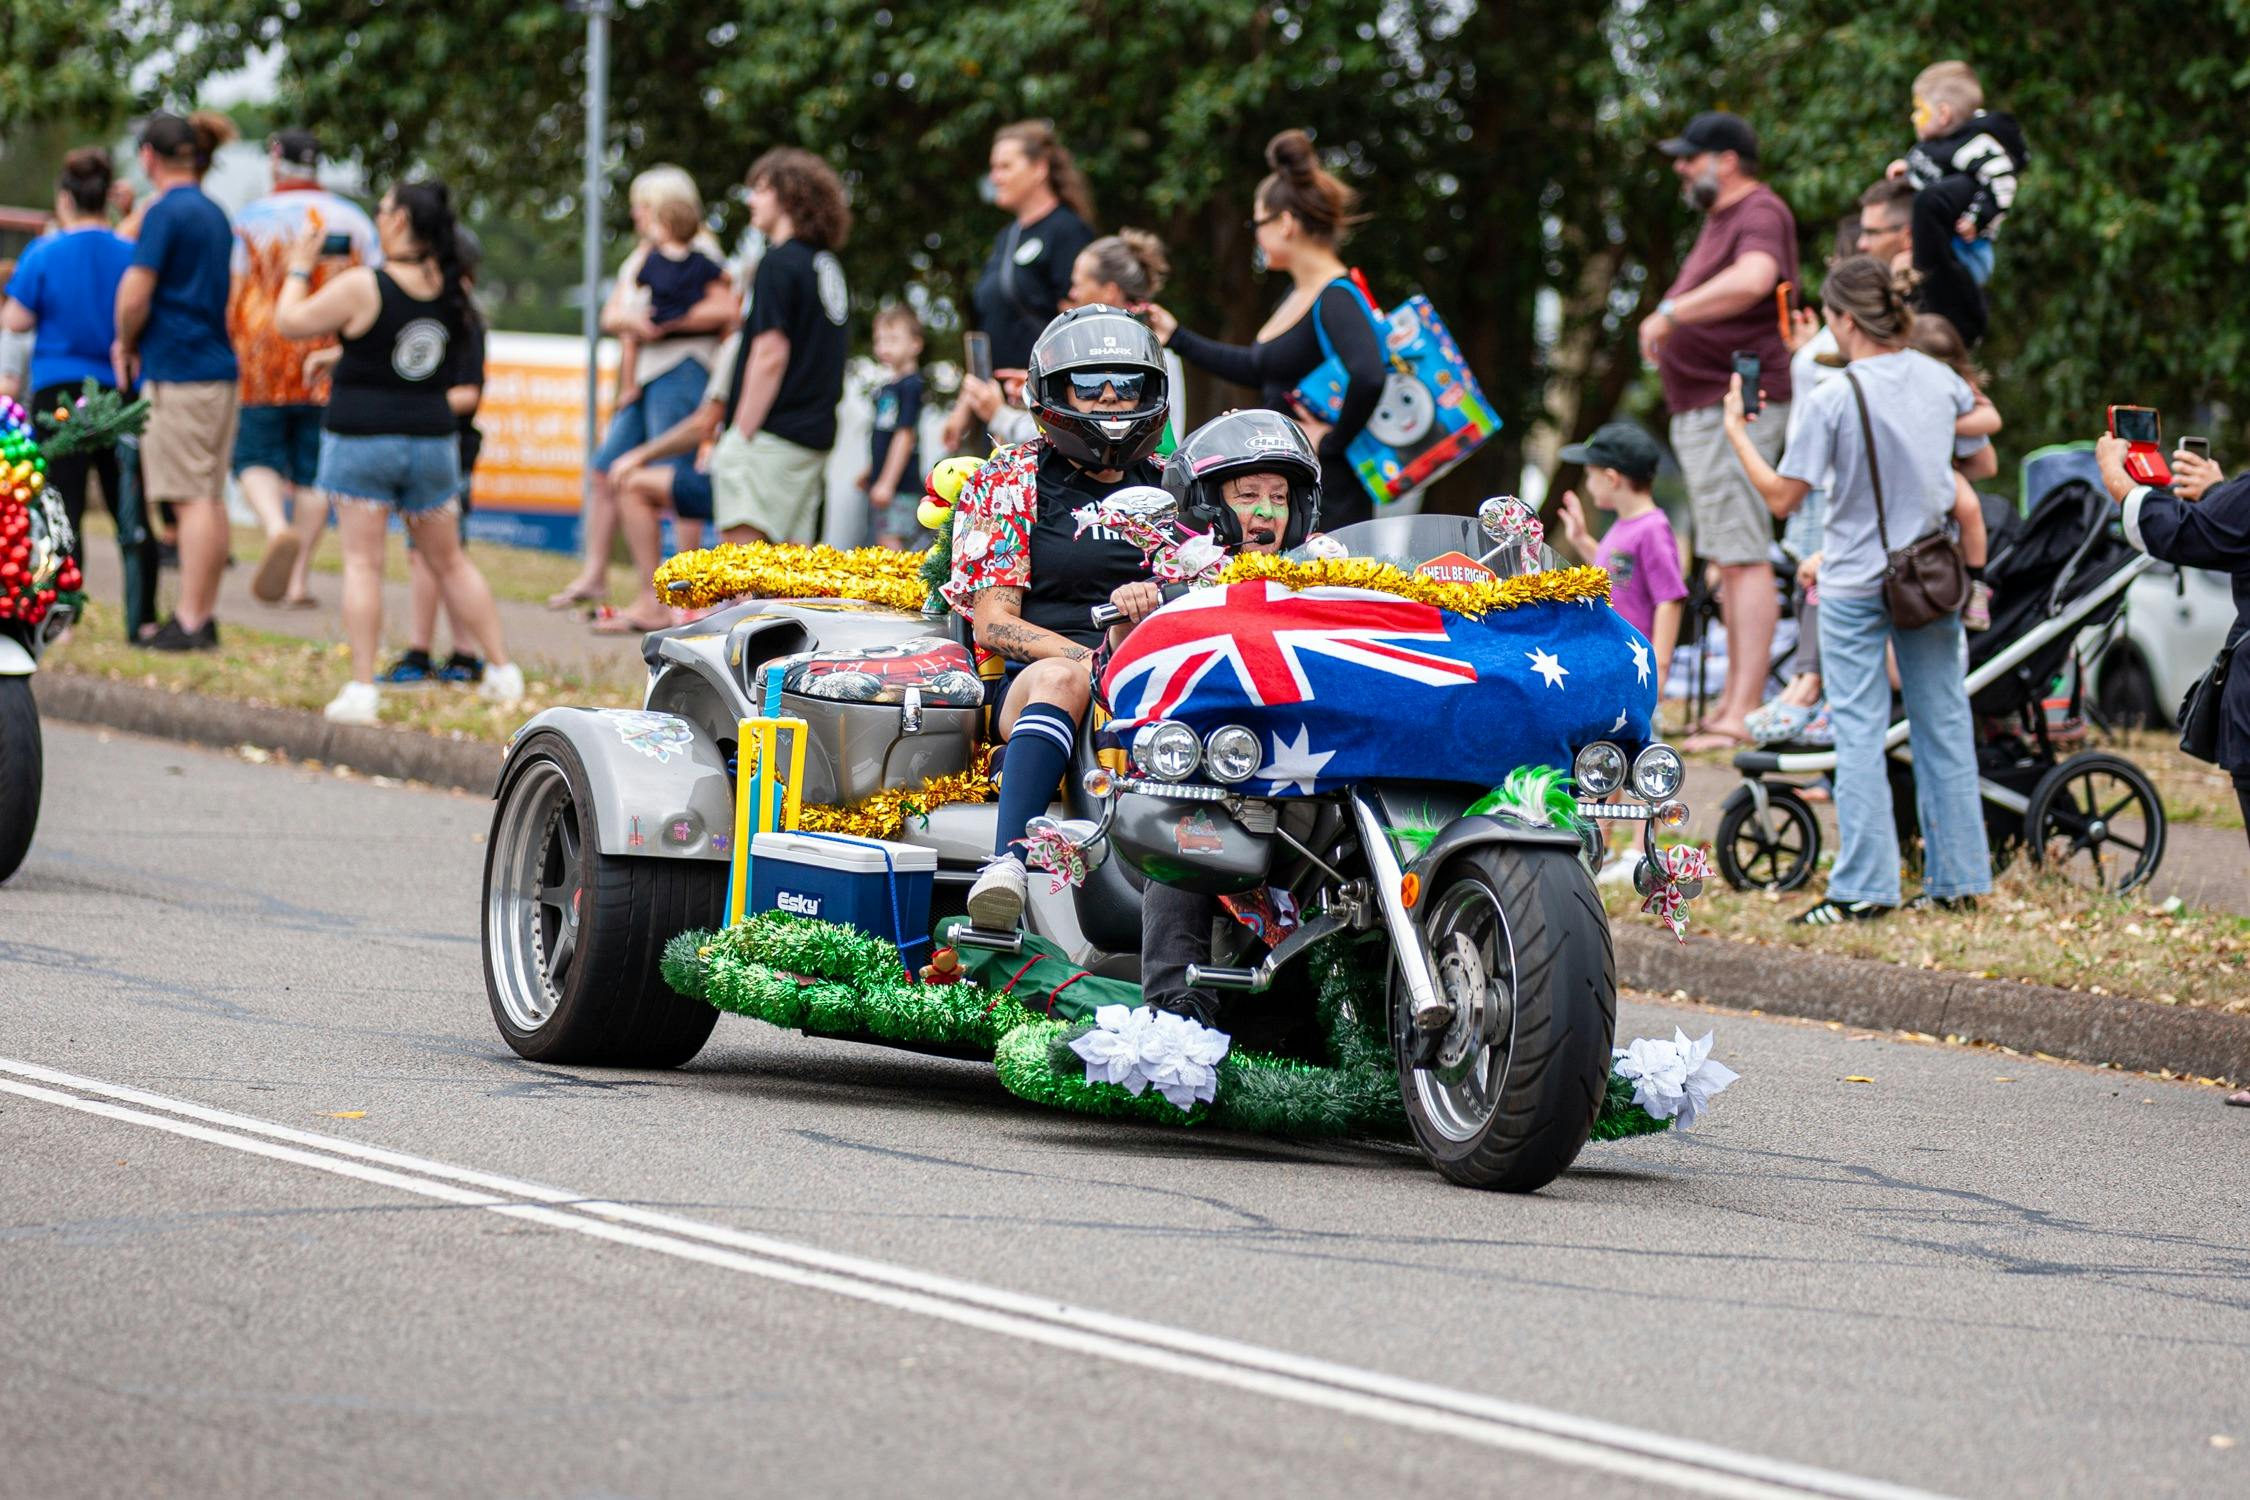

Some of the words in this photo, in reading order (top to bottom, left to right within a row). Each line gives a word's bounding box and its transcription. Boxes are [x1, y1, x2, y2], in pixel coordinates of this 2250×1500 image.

[1422, 565, 1451, 580] SHE'LL
[1452, 566, 1463, 581] BE
[1465, 567, 1490, 585] RIGHT
[778, 891, 818, 916] Esky
